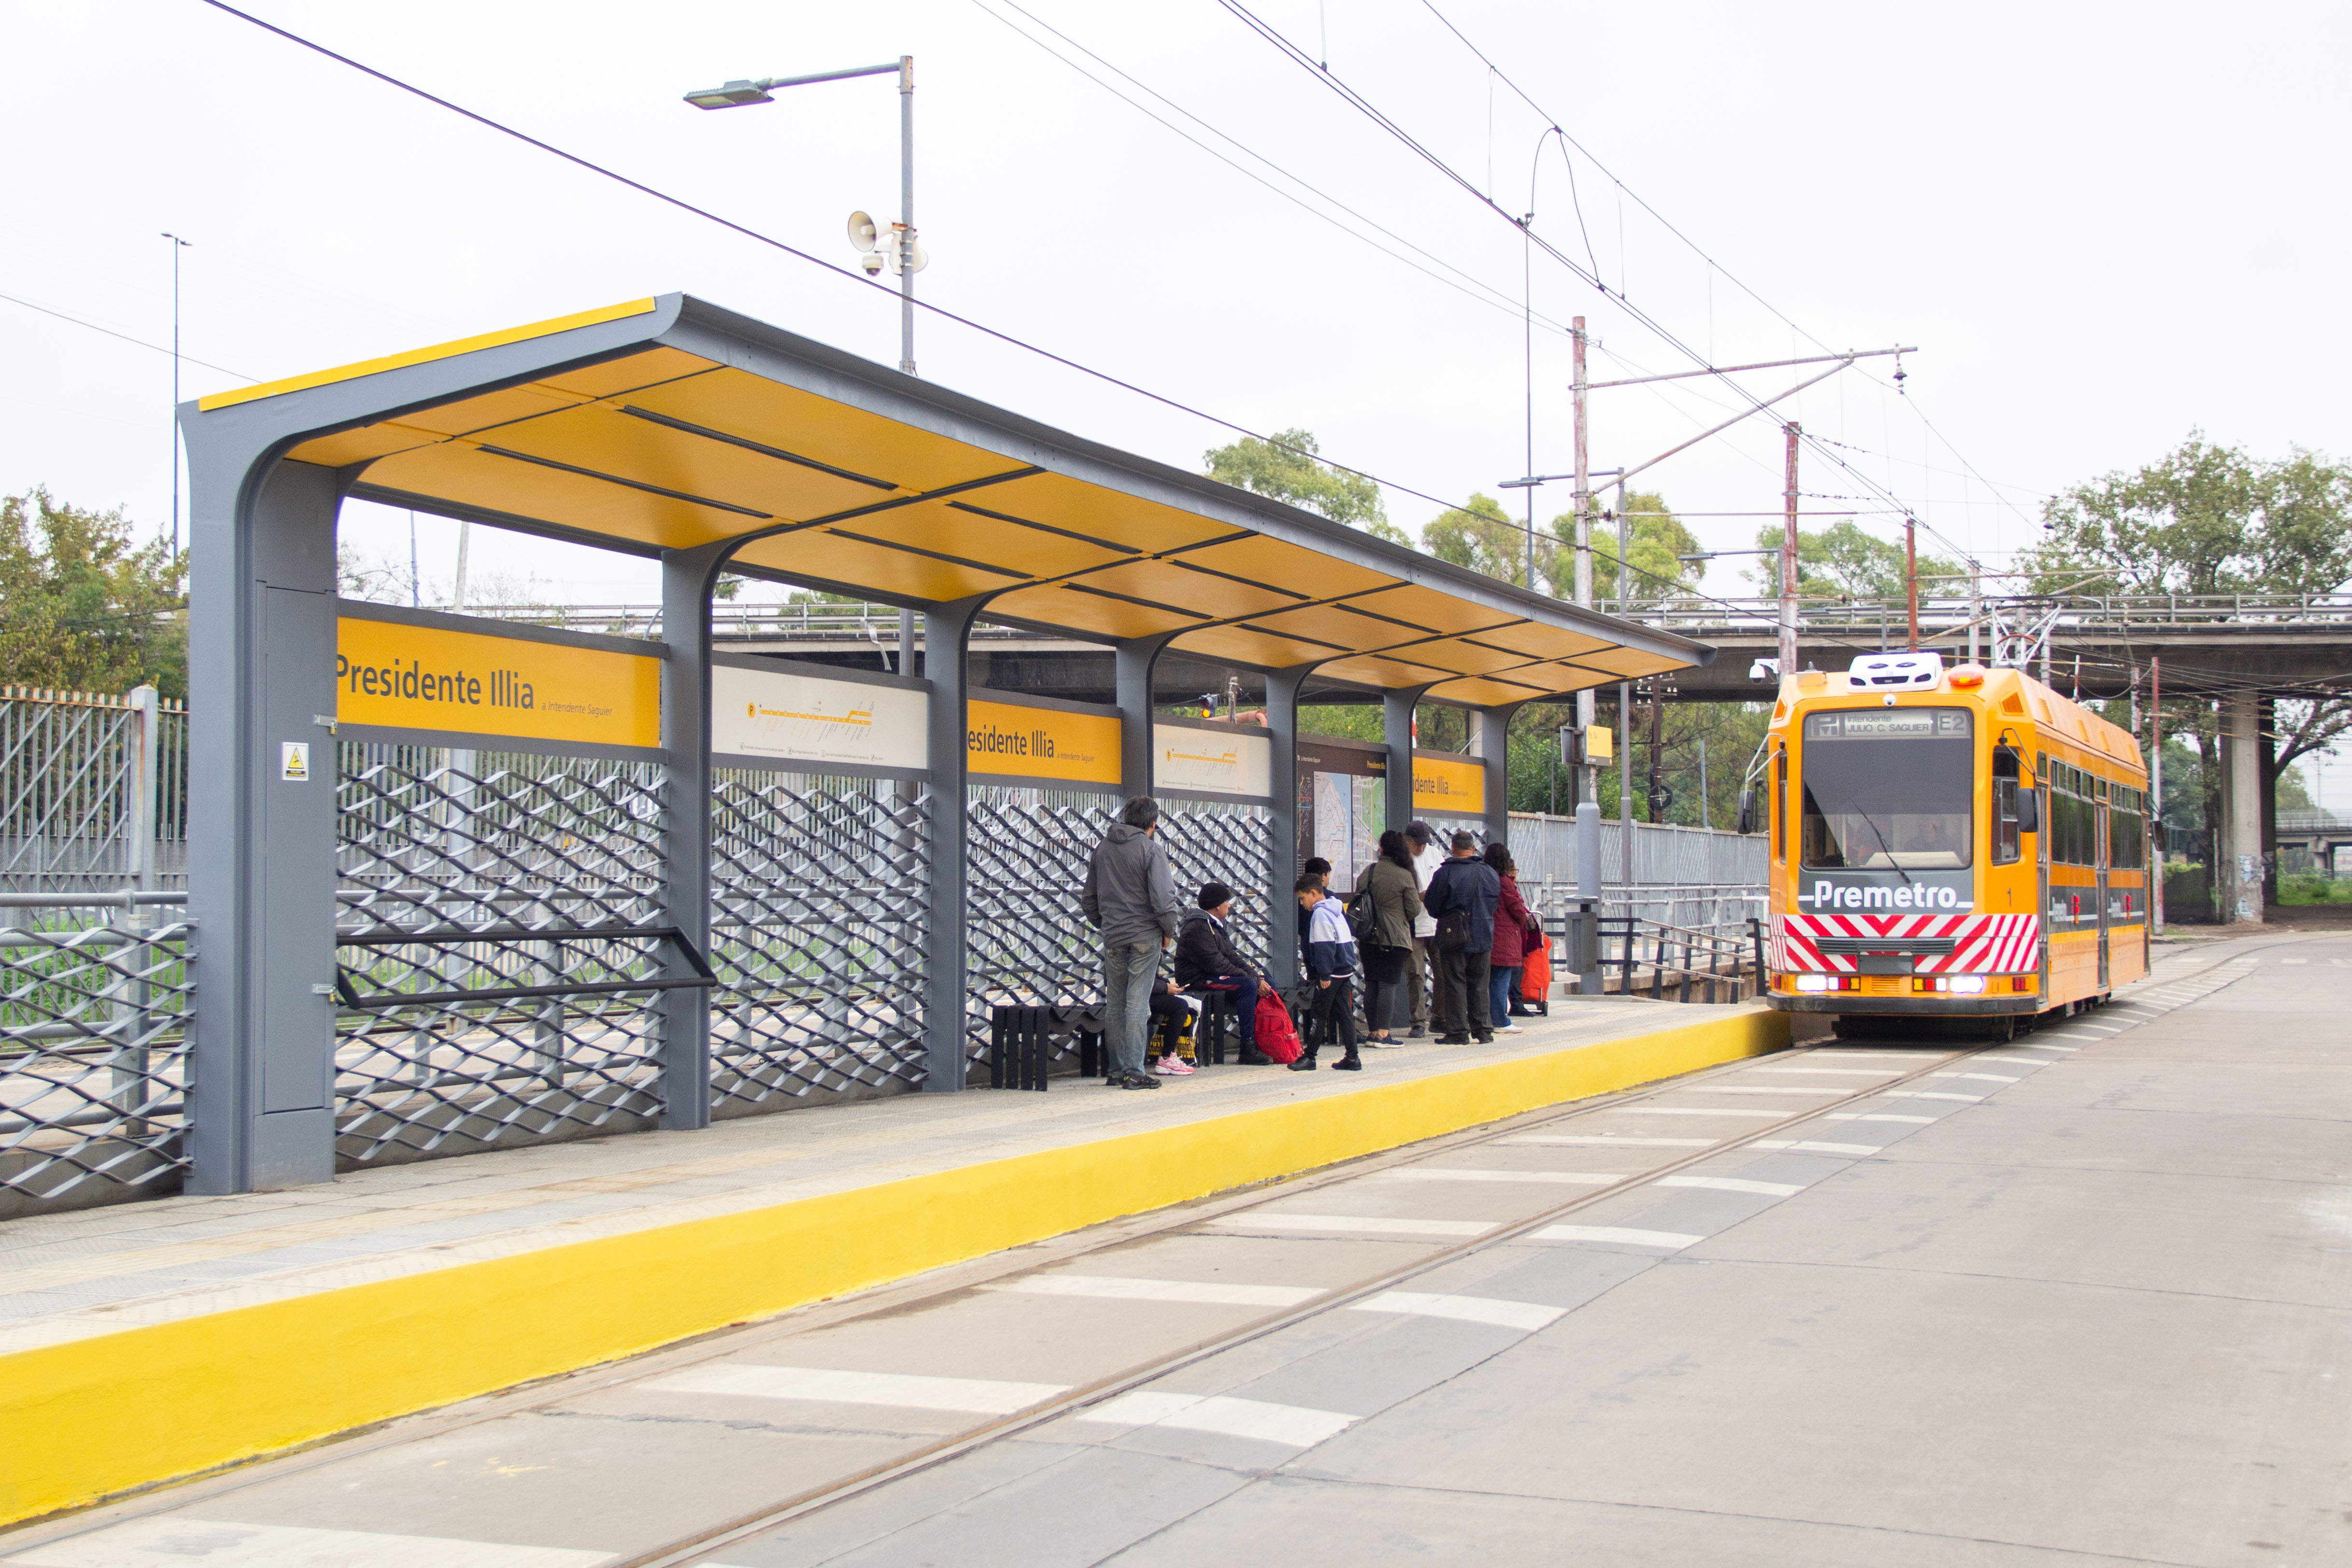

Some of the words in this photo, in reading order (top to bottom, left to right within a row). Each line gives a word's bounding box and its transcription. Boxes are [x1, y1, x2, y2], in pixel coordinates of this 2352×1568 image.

[337, 654, 481, 705] Presidente
[491, 670, 534, 709] Illia
[542, 702, 546, 710] a
[548, 701, 586, 714] Intendente
[588, 704, 612, 718] Saguier
[1848, 715, 1892, 723] Intendente
[1848, 724, 1873, 733] JULIO
[1889, 724, 1929, 732] SAGUIER
[1940, 716, 1965, 731] E2
[968, 724, 1027, 756] esidente
[1032, 730, 1054, 758] Illia
[1412, 773, 1435, 793] idente
[1437, 775, 1448, 794] Illia
[1815, 880, 1957, 908] Premetro
